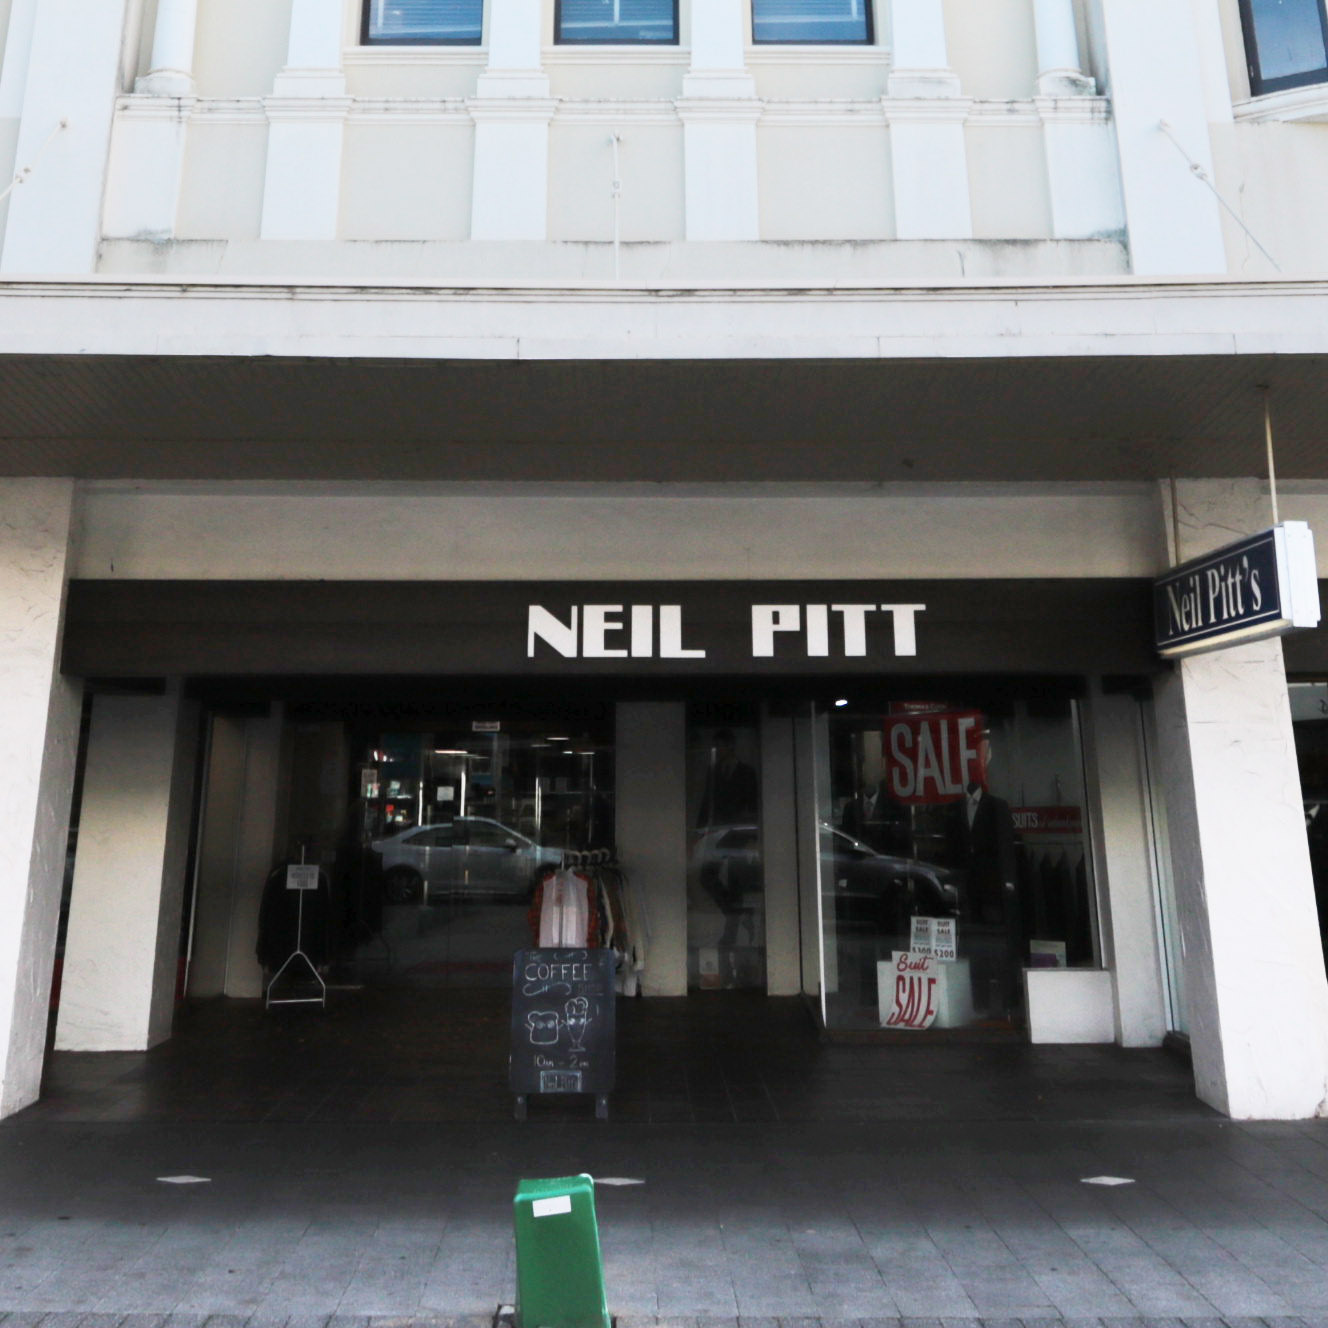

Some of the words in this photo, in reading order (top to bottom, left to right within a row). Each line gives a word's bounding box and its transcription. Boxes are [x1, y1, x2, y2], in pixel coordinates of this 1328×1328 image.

[1166, 574, 1203, 636] Neil
[1206, 554, 1262, 624] Pitt's
[527, 604, 706, 658] NEIL
[752, 603, 926, 657] PITT
[890, 717, 978, 798] SALE
[524, 963, 593, 981] COFFEE
[897, 953, 933, 972] Suit
[886, 974, 937, 1028] SALE
